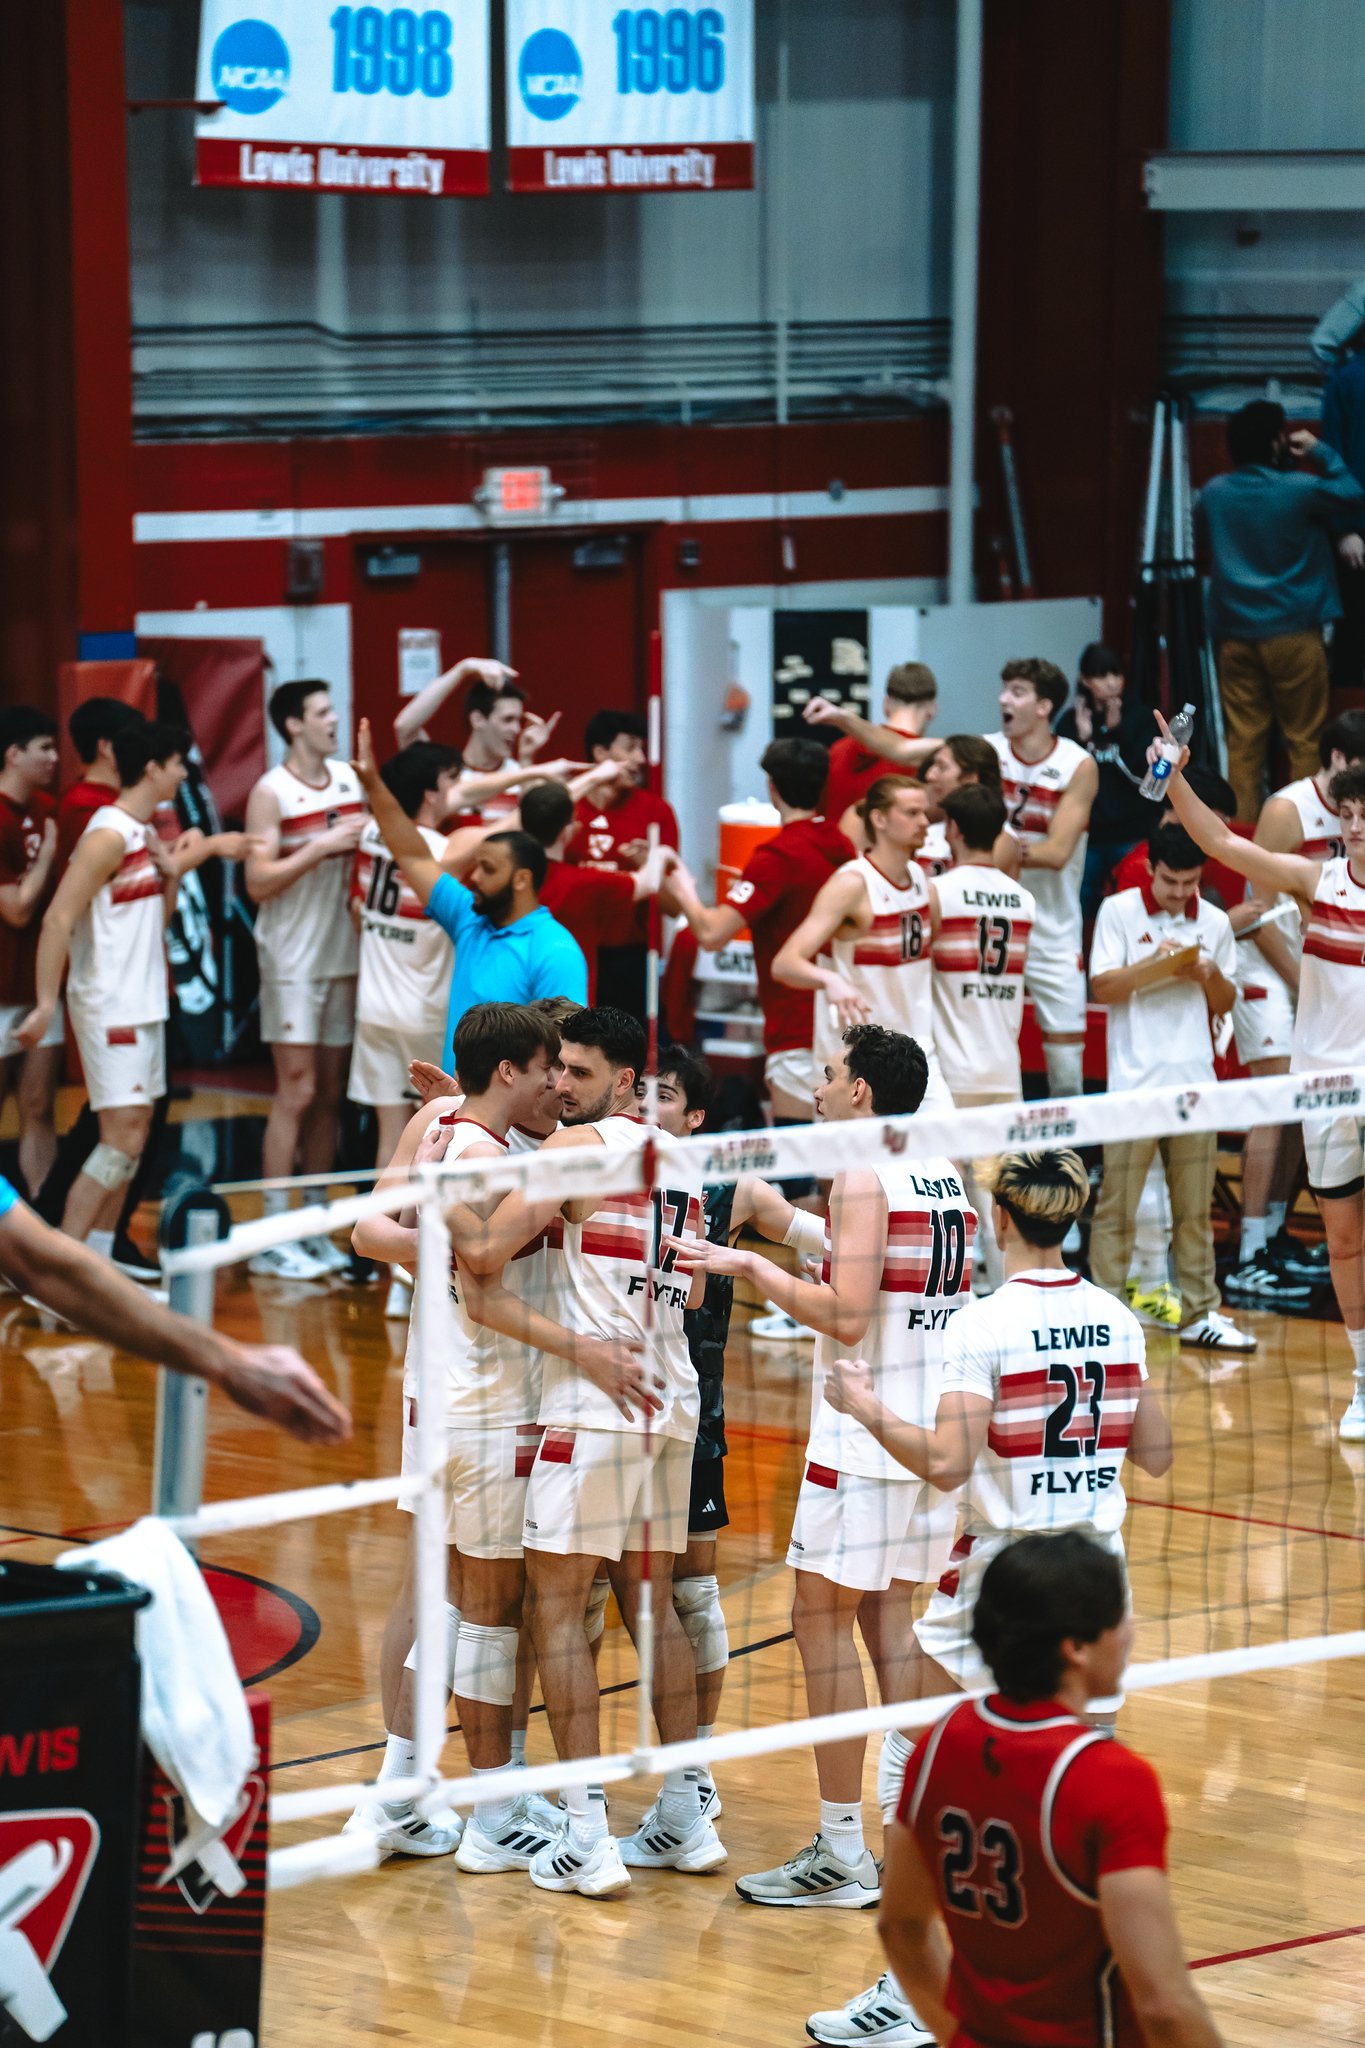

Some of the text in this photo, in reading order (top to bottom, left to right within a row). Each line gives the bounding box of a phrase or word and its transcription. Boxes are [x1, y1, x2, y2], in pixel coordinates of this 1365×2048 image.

[330, 5, 453, 98] 1998
[612, 8, 725, 95] 1996
[240, 143, 446, 195] Lewis University
[543, 147, 716, 188] Lewis University
[366, 855, 400, 916] 16
[963, 889, 1021, 909] LEWIS
[901, 911, 923, 960] 18
[976, 914, 1012, 977] 13
[1294, 1088, 1362, 1111] FLYERS
[1007, 1119, 1077, 1143] FLYERS
[650, 1186, 690, 1274] 17
[925, 1208, 966, 1298] 10
[1031, 1324, 1111, 1352] LEWIS
[1043, 1360, 1106, 1458] 23
[938, 1804, 1029, 1931] 23
